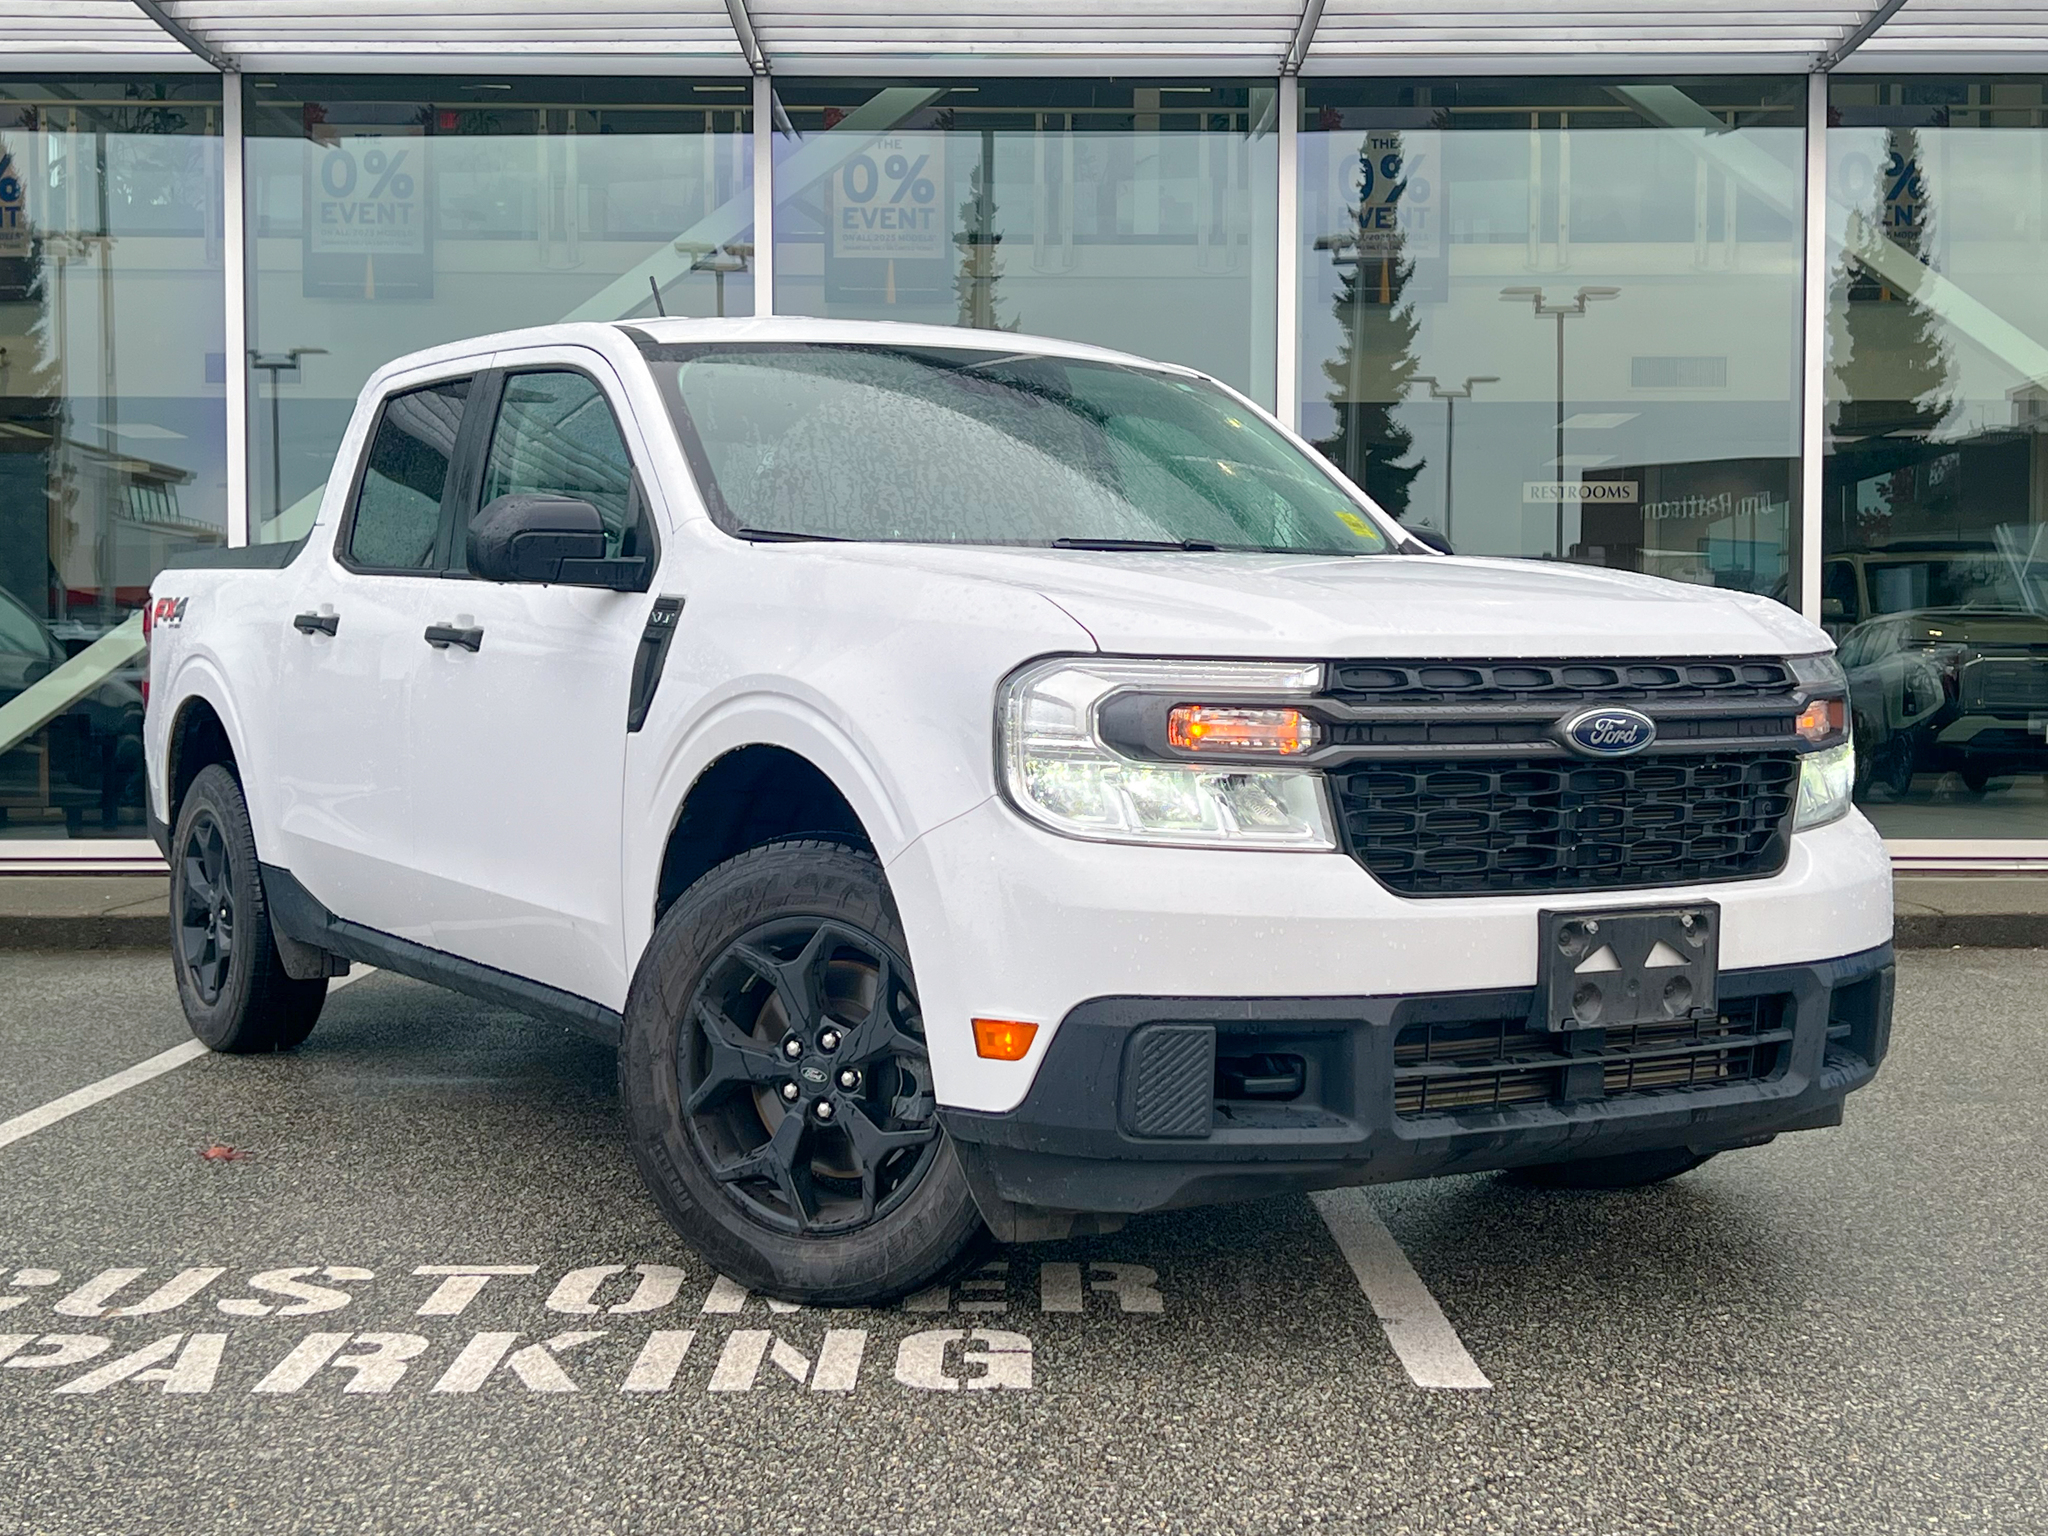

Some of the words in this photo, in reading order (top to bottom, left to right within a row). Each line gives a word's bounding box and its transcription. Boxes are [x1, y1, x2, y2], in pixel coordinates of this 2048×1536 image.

[876, 139, 902, 150] THE
[1371, 138, 1399, 149] THE
[321, 149, 415, 199] 0%
[842, 153, 936, 204] 0%
[1338, 153, 1431, 203] 0%
[321, 202, 415, 224] EVENT
[842, 207, 936, 229] EVENT
[875, 233, 896, 242] 2025
[1530, 485, 1630, 499] RESTROOMS
[154, 597, 189, 628] FX4
[1590, 718, 1638, 745] Ford
[0, 1261, 1164, 1317] USTOER
[0, 1329, 1033, 1394] PARKING
